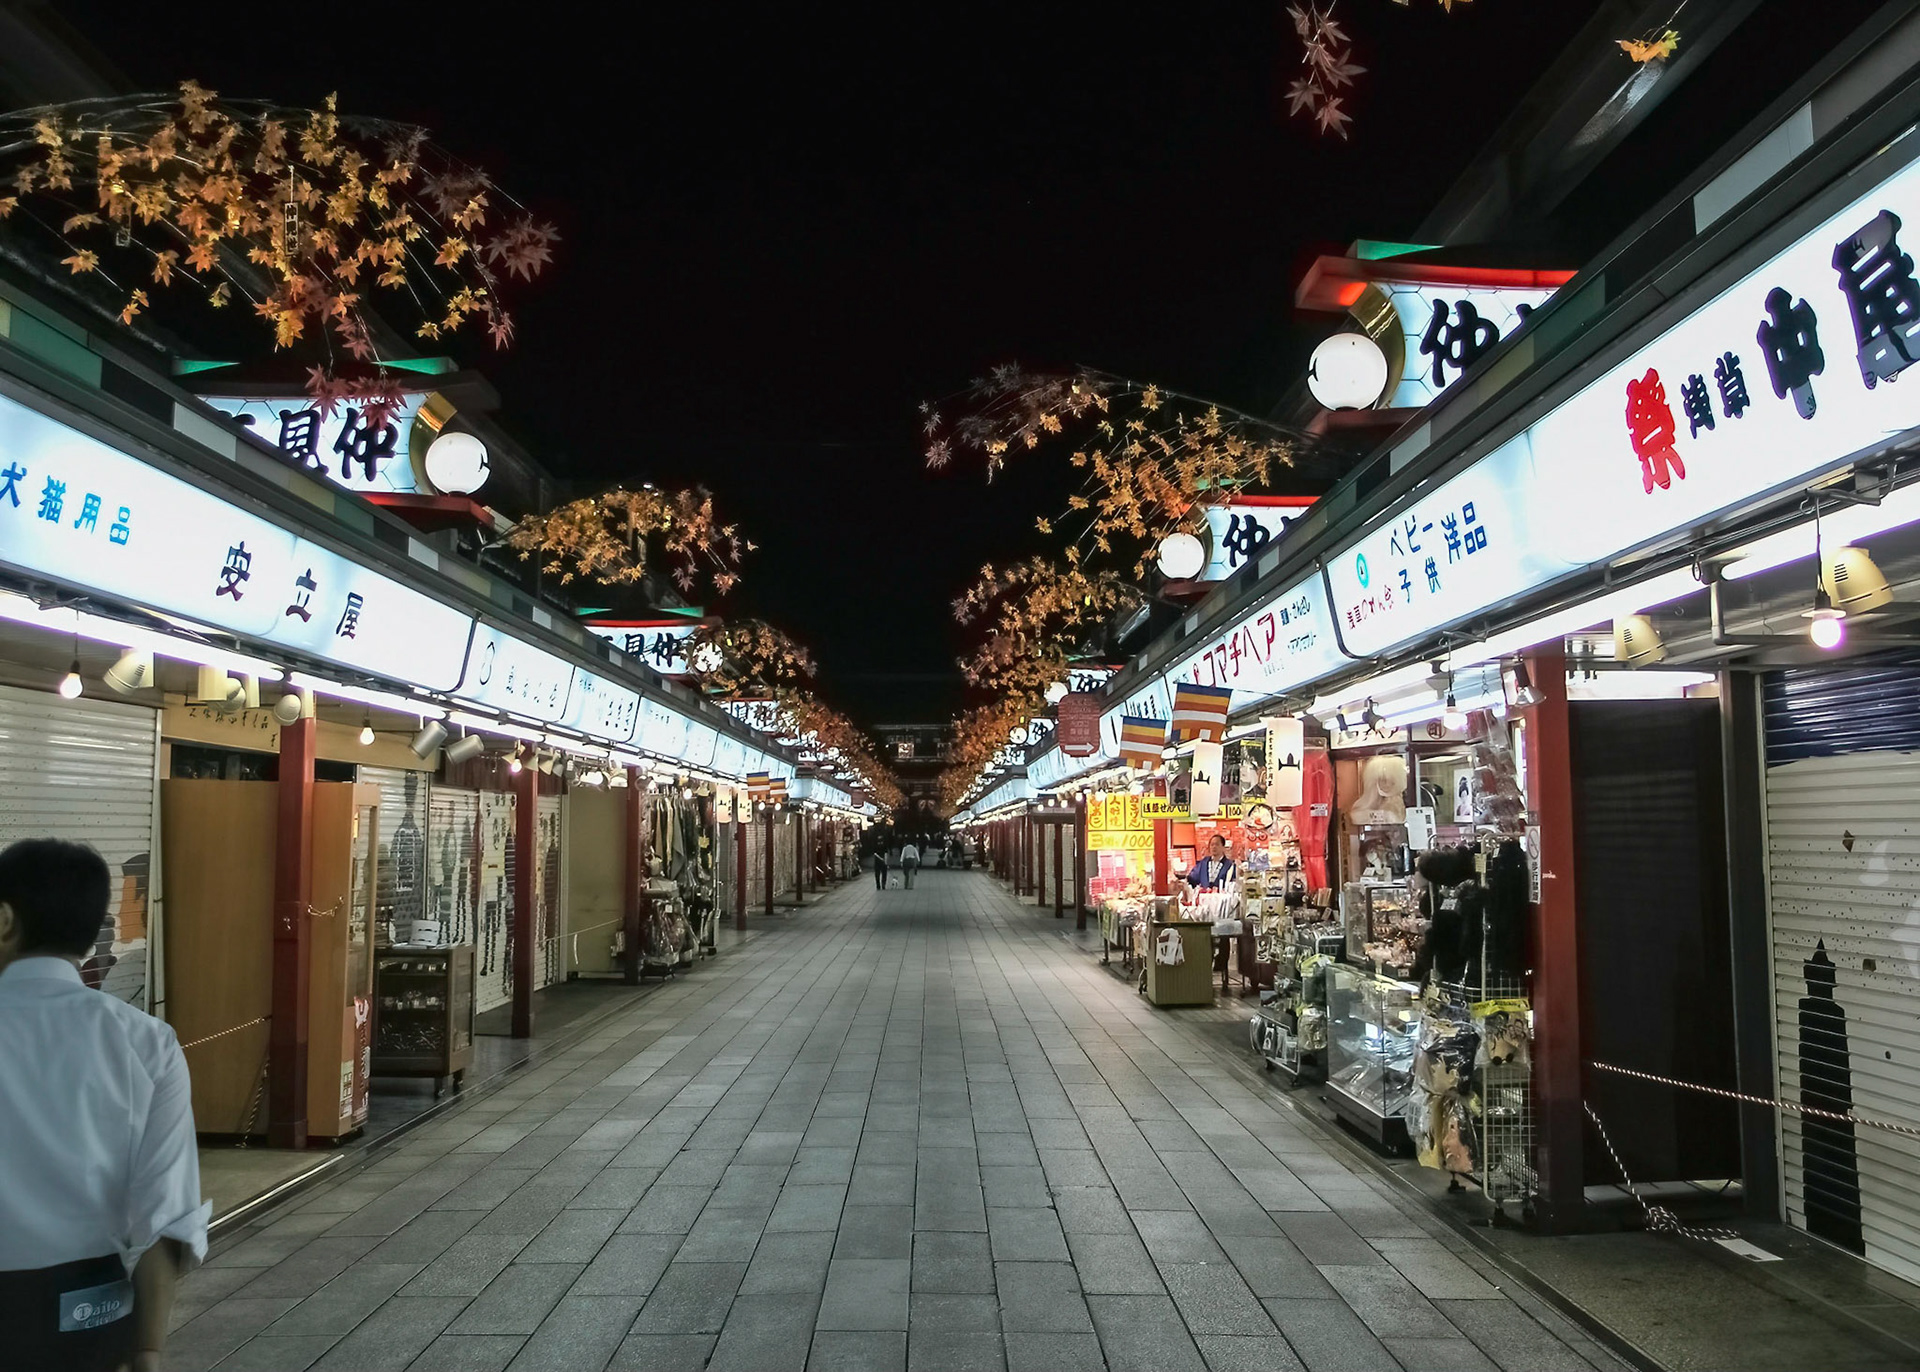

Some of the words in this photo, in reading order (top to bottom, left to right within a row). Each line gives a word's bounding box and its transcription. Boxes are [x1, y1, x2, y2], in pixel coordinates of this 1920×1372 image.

[0, 461, 131, 546] 犬猫用品
[1390, 515, 1434, 556] ベビー
[1441, 501, 1488, 565] 洋品
[1398, 556, 1442, 603] 子供
